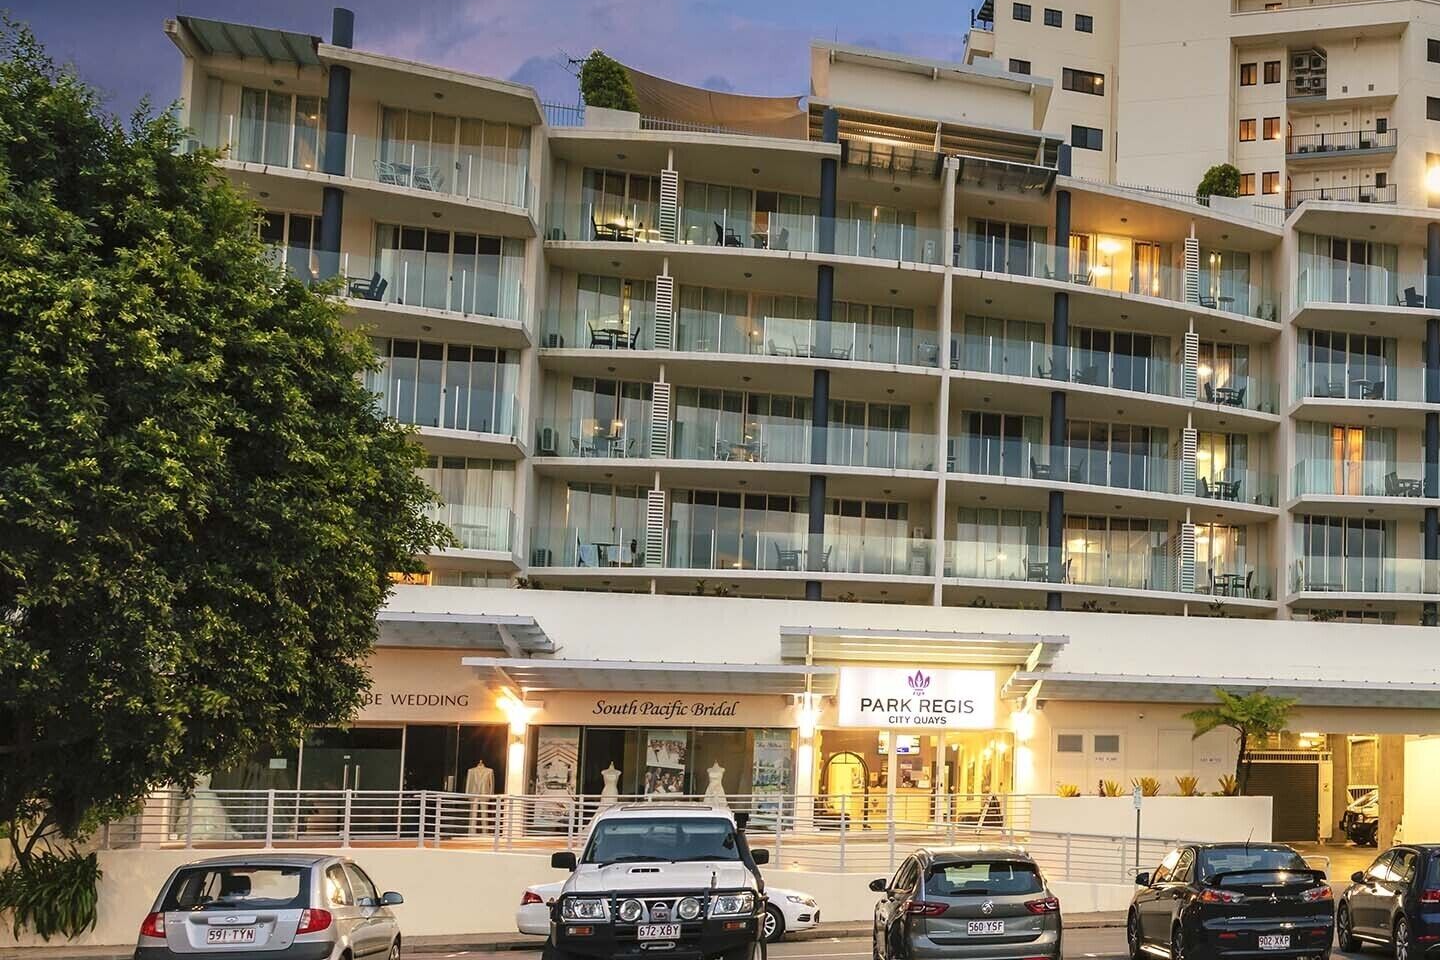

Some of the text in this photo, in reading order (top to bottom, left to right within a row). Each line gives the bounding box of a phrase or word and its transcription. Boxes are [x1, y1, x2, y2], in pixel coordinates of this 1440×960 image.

[391, 693, 469, 707] WEDDING
[860, 698, 975, 714] PARK REGIS
[592, 699, 740, 720] South Pacific Bridal
[888, 715, 947, 725] CITY QUAYS
[640, 926, 656, 936] 672
